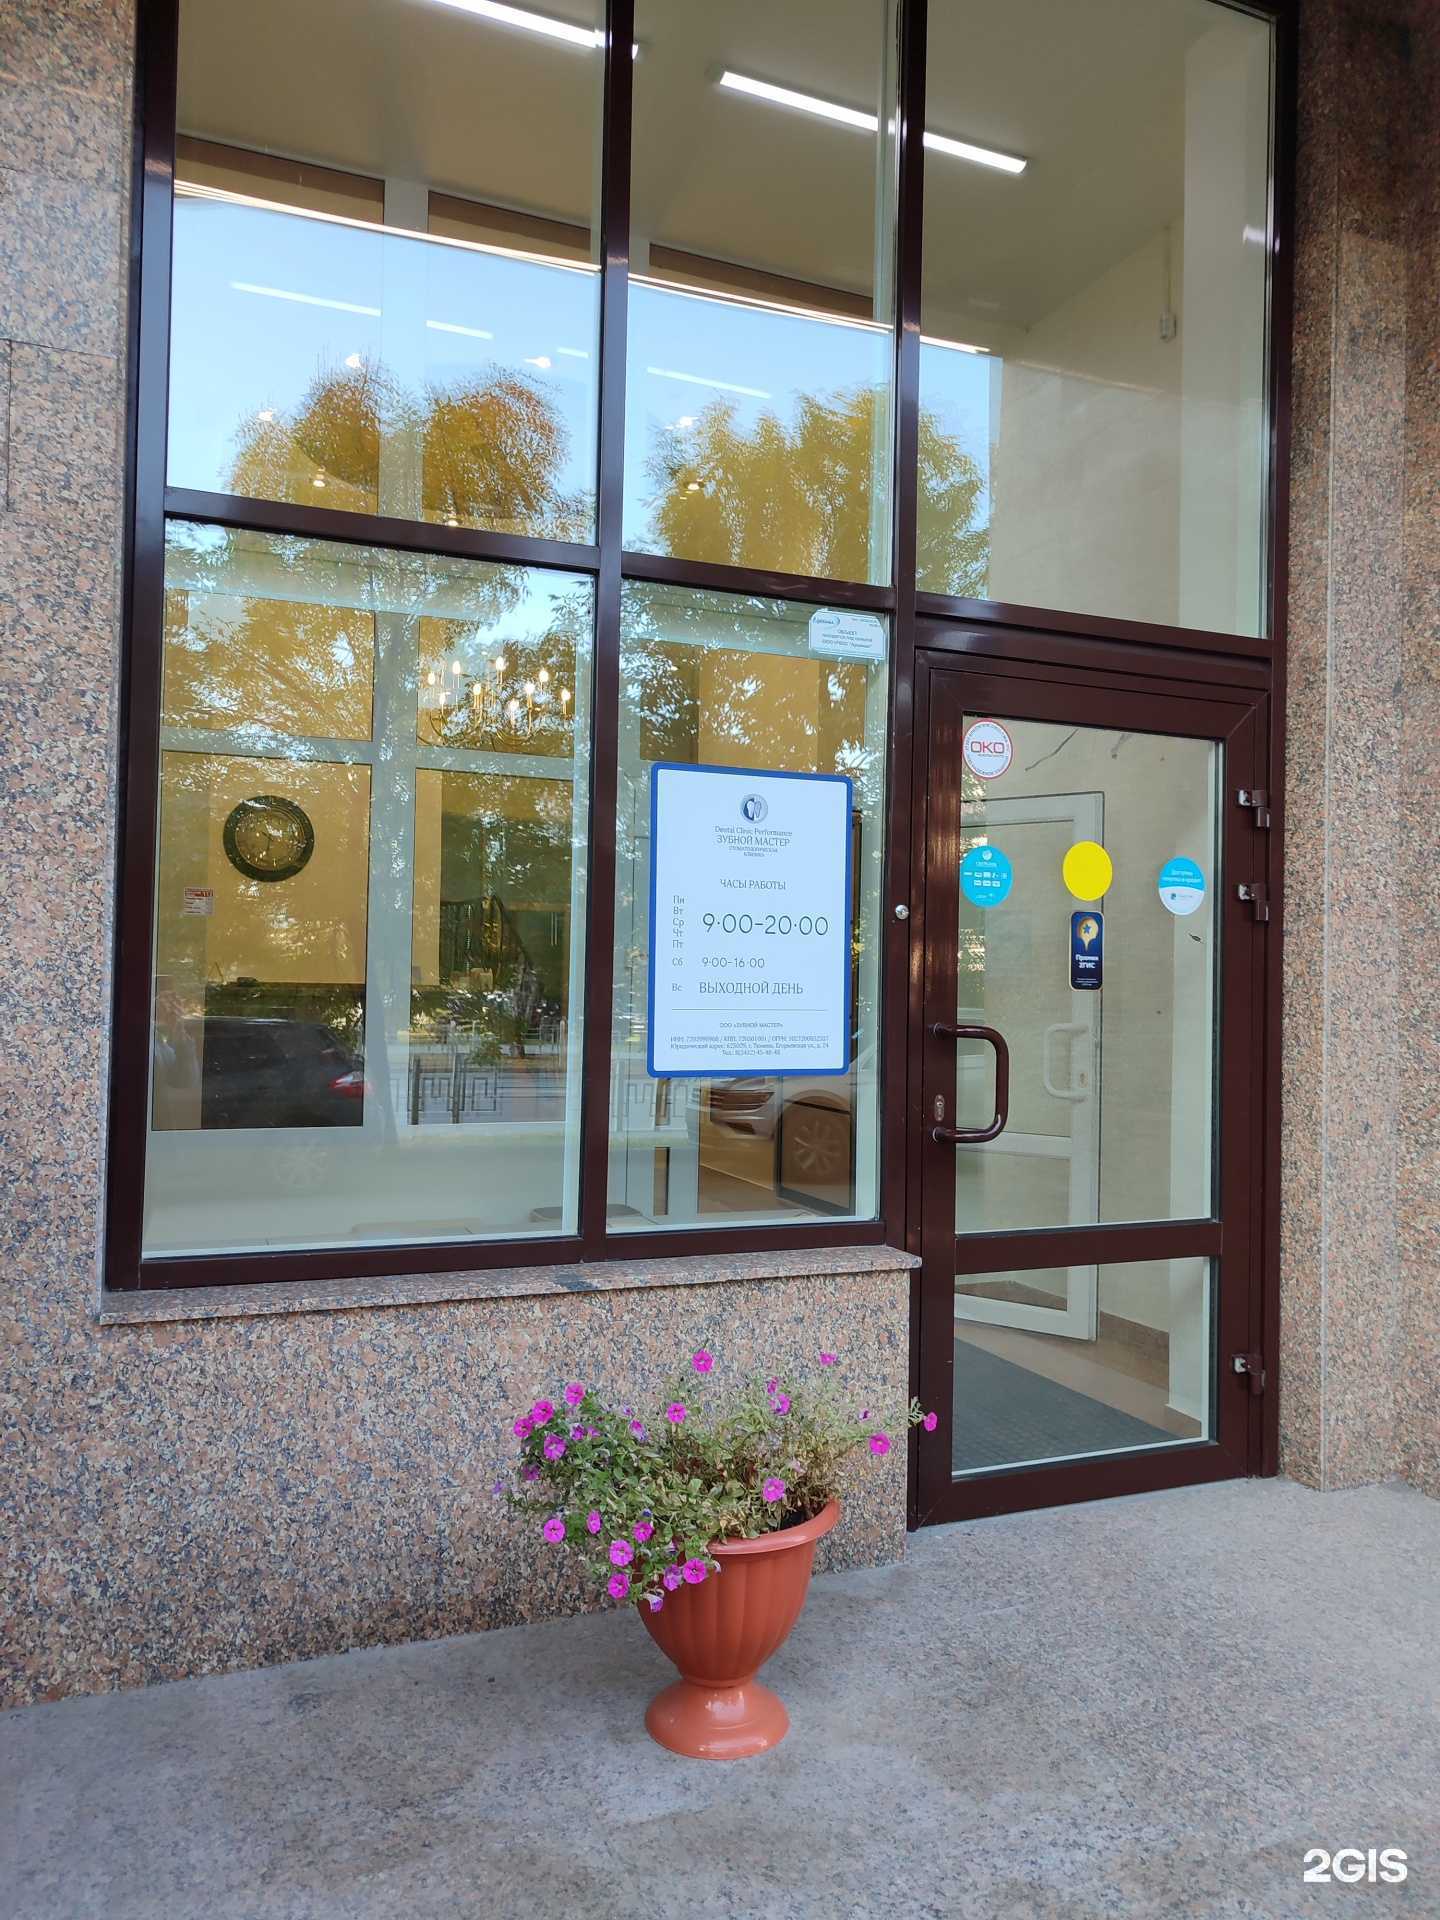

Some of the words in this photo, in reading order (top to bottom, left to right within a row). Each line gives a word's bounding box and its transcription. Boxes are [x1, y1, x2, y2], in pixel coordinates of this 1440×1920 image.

[715, 826, 735, 834] Dental
[717, 834, 753, 846] ЗУБНОЙ
[755, 837, 791, 847] МАСТЕР
[720, 879, 747, 889] ЧАСЫ
[749, 880, 786, 890] РАБОТЫ
[673, 895, 685, 905] Пн
[673, 906, 684, 915] Вт
[673, 918, 685, 928] Ср
[673, 929, 684, 938] Чт
[672, 939, 684, 949] Пт
[672, 957, 683, 967] Сб
[672, 983, 683, 992] Вс
[699, 980, 769, 995] ВЫХОДНОЙ
[772, 983, 804, 995] ДЕНЬ
